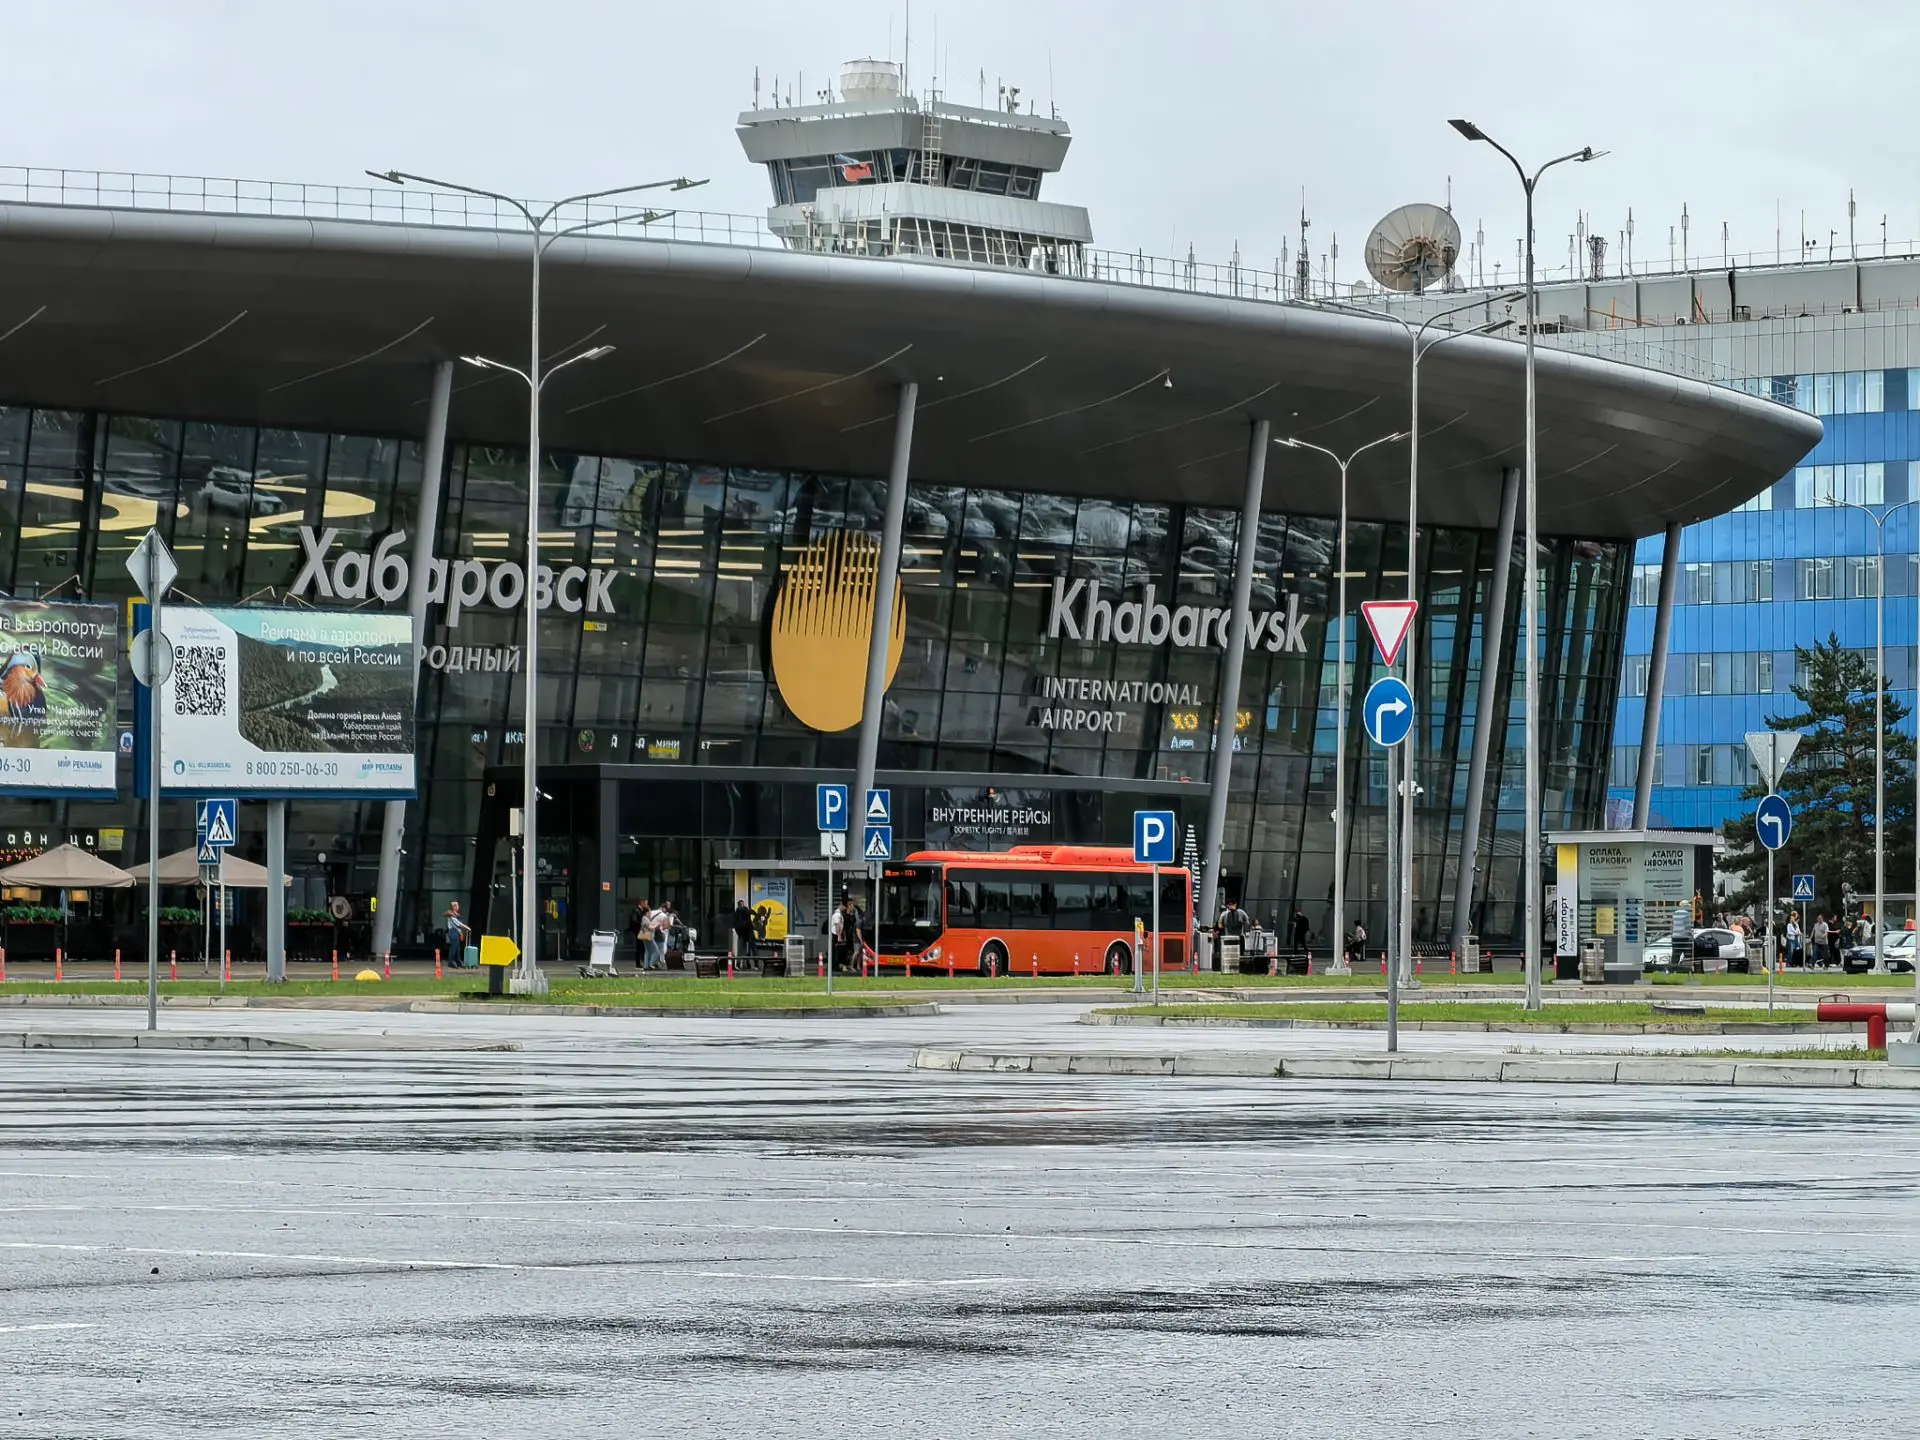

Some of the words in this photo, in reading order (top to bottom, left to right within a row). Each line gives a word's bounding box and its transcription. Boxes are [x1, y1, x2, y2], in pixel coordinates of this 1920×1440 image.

[26, 618, 104, 640] аэропорту
[260, 621, 316, 640] Реклама
[321, 629, 327, 638] в
[331, 629, 400, 648] аэропорту
[13, 639, 47, 656] всей
[52, 639, 104, 660] России
[286, 650, 295, 662] и
[300, 651, 315, 663] по
[320, 647, 350, 664] всей
[354, 648, 401, 665] России
[1043, 676, 1202, 706] INTERNATIONAL
[307, 709, 335, 720] Долина
[336, 711, 361, 723] горной
[362, 713, 380, 723] реки
[1040, 707, 1127, 732] AIRPORT
[246, 762, 253, 775] 8
[256, 762, 277, 776] 800
[280, 762, 338, 776] 250-06-30
[933, 807, 1009, 824] ВНУТРЕННИЕ
[1012, 807, 1051, 825] РЕЙСЫ
[1589, 848, 1622, 856] ОПЛАТА
[1589, 857, 1632, 865] ПАРКОВКИ
[1559, 896, 1569, 952] Аэропорт
